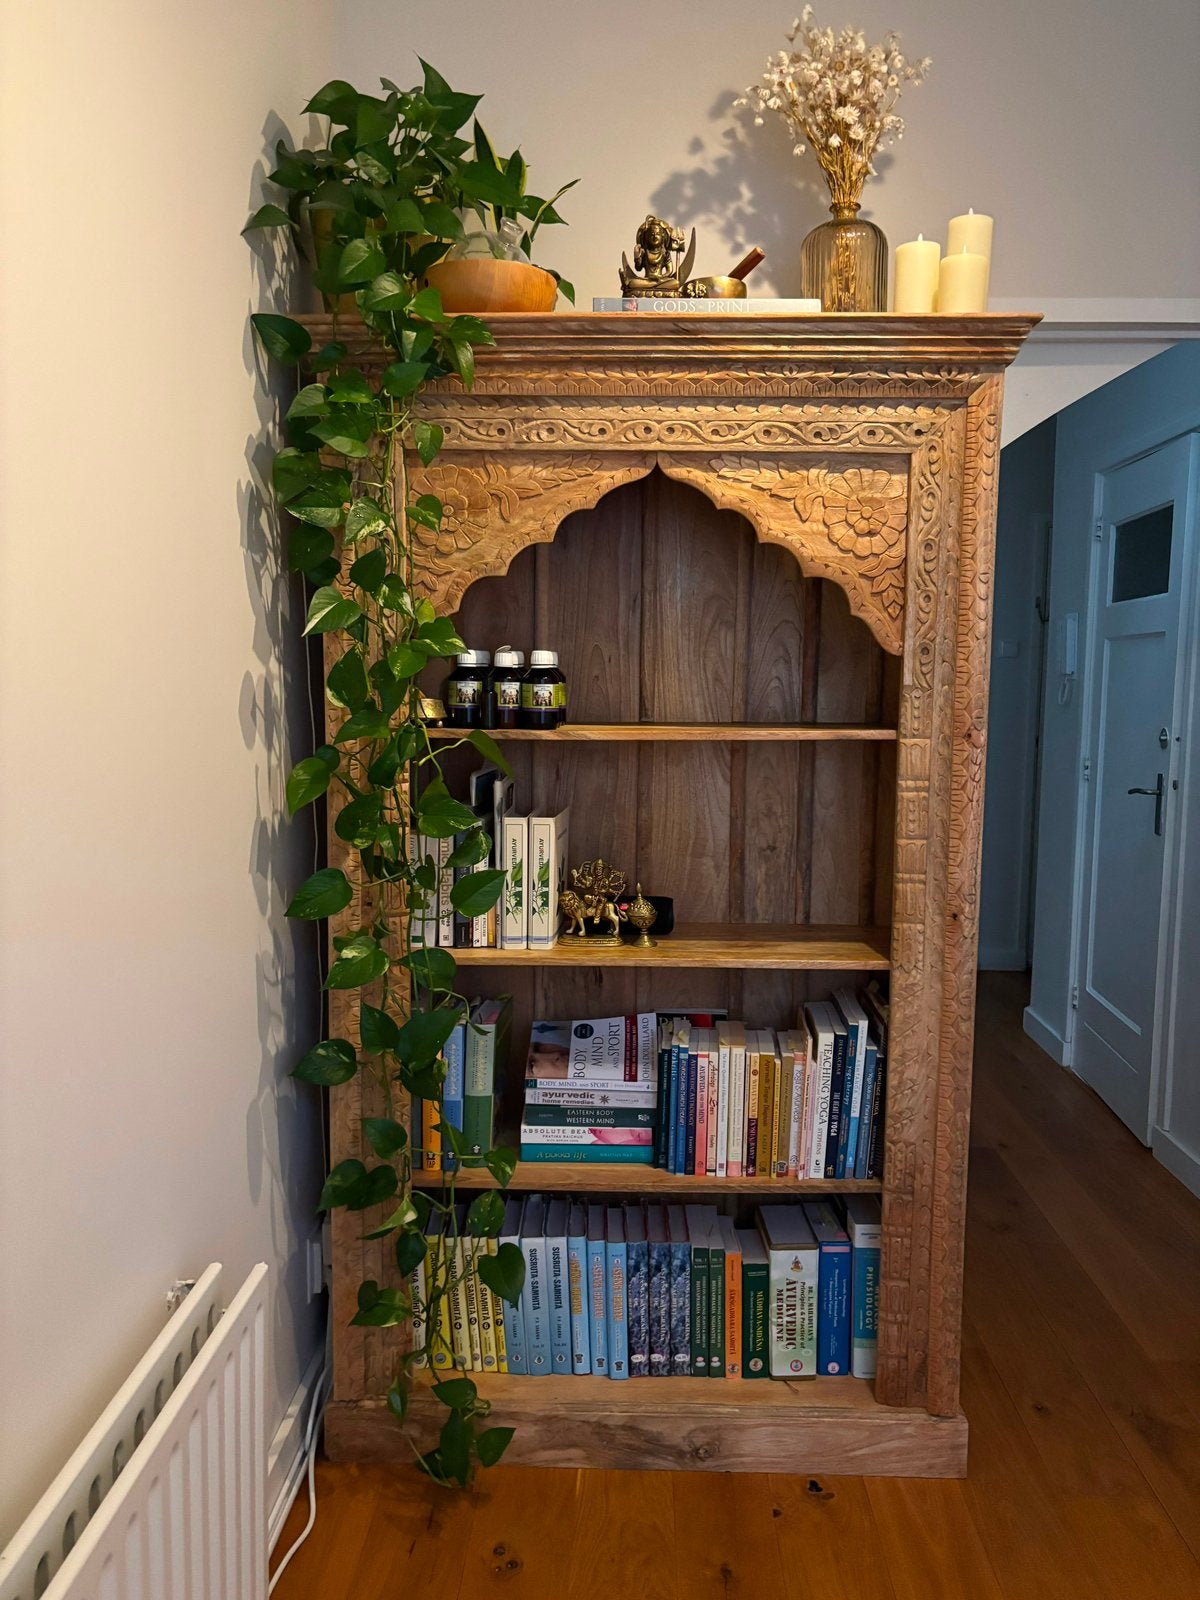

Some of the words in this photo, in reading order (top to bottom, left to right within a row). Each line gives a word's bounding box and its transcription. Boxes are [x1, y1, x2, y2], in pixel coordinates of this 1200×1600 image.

[653, 301, 696, 312] GODS
[708, 302, 751, 313] PRINT
[441, 868, 453, 906] Habits
[592, 1035, 604, 1066] MIND,
[608, 1022, 620, 1057] SPORT
[642, 1018, 650, 1060] DOUILLARD
[573, 1048, 588, 1078] BODY,
[794, 1070, 802, 1084] Yoga
[820, 1042, 834, 1093] TEACHING
[542, 1091, 595, 1100] ayurvedic
[792, 1092, 802, 1123] Ayurveda
[843, 1081, 852, 1105] therapy
[818, 1096, 830, 1124] YOGA
[830, 1121, 838, 1136] YOGA
[866, 1266, 874, 1330] PHYSIOLOGY
